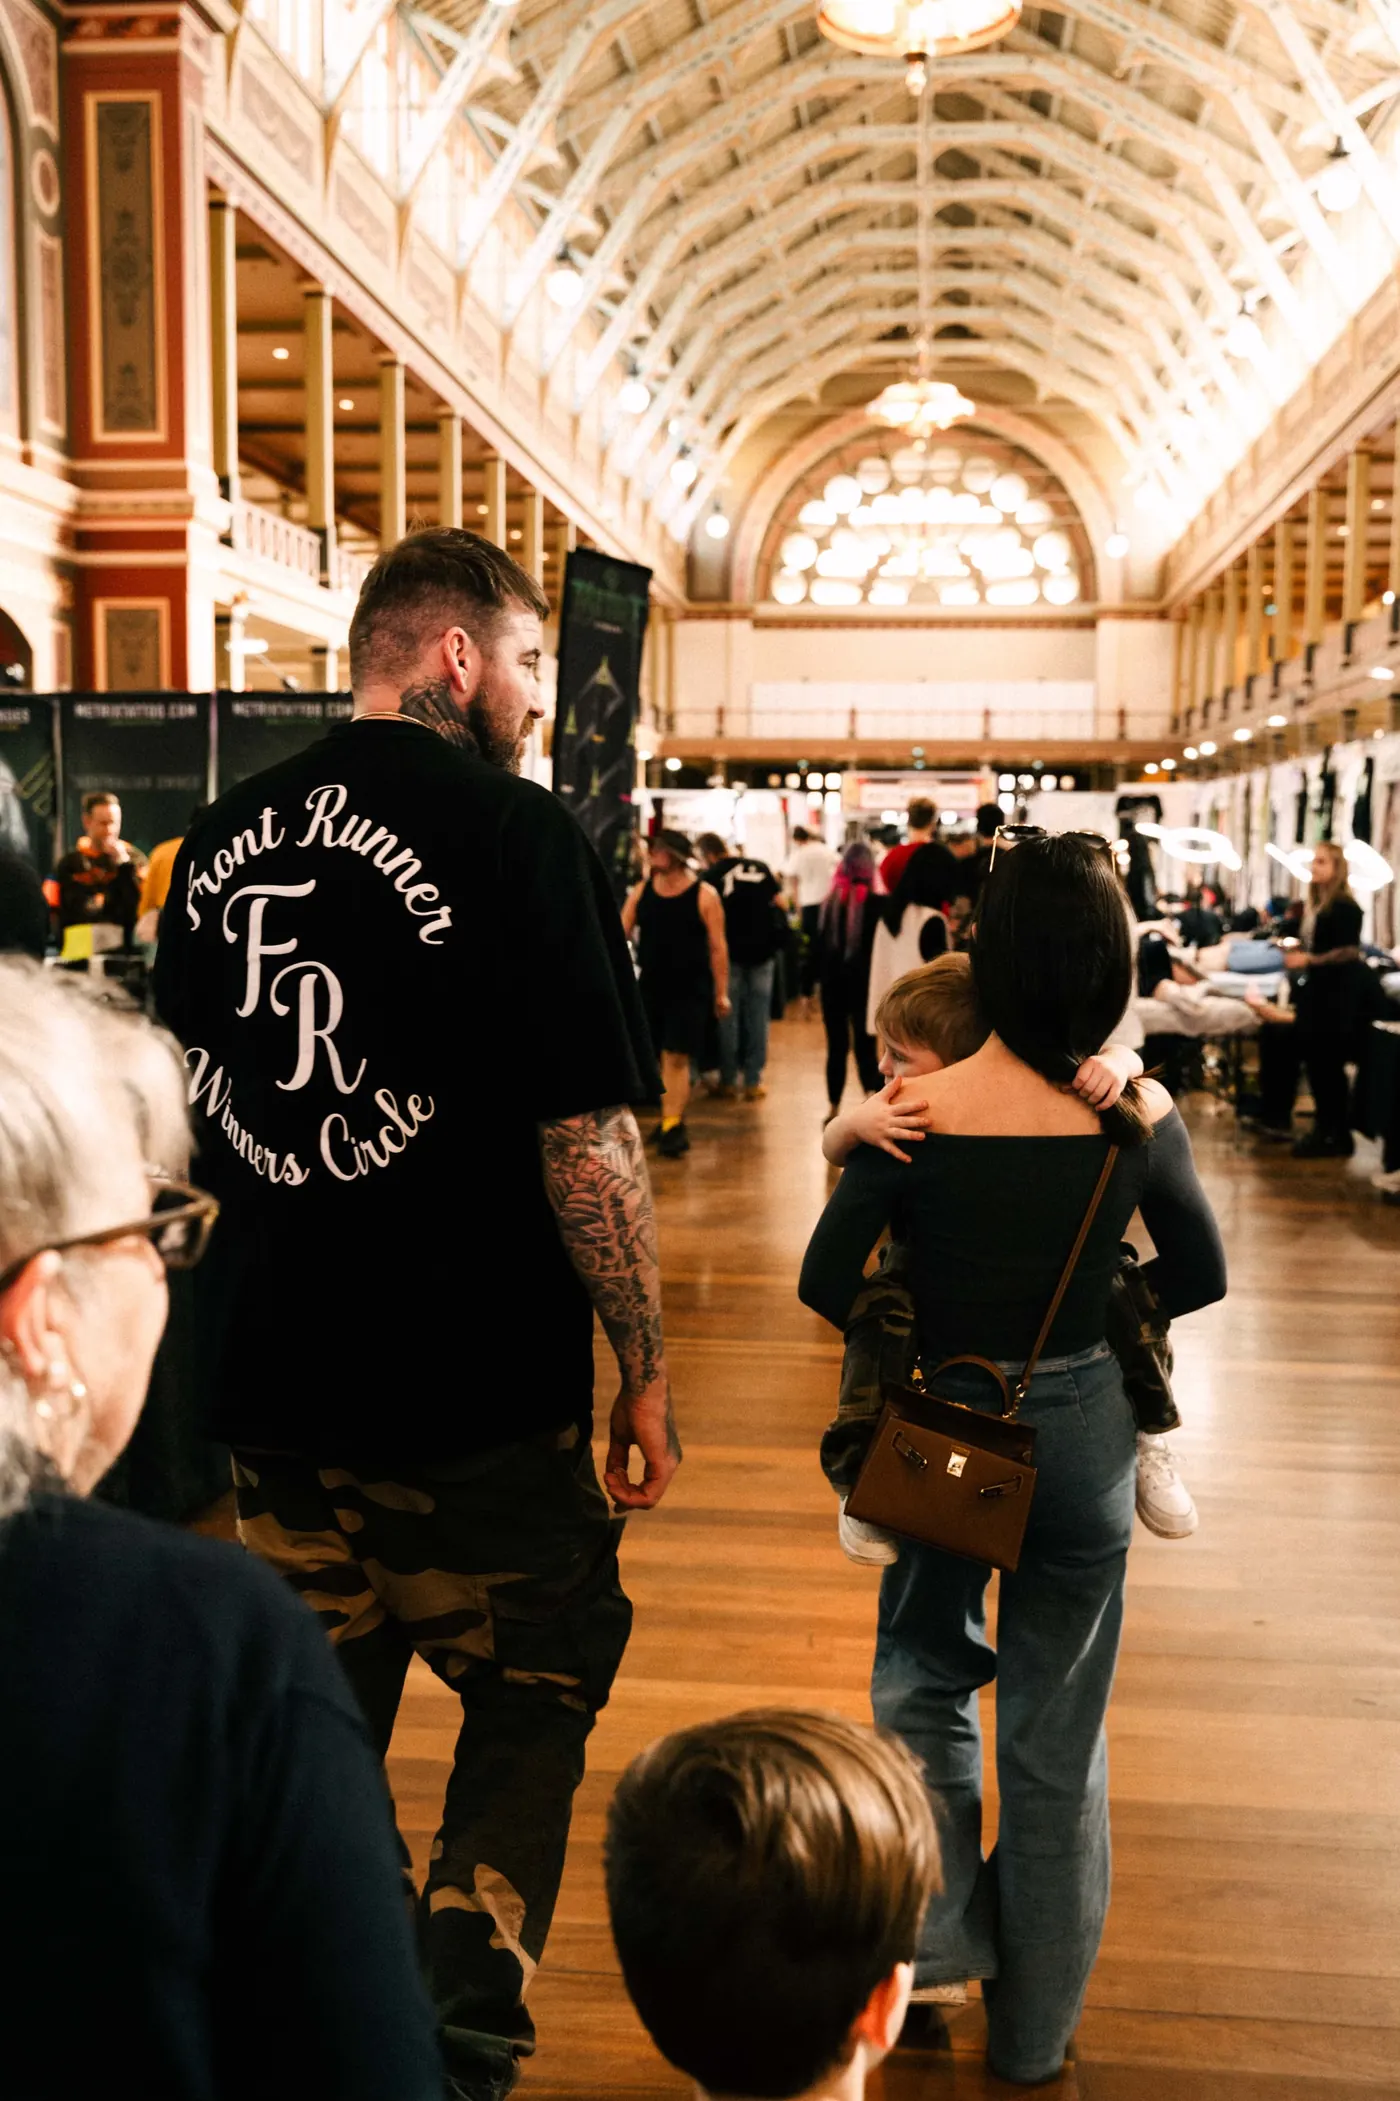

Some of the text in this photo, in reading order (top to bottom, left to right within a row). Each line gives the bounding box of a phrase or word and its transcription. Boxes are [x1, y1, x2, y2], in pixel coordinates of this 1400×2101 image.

[295, 784, 453, 945] Runner
[184, 1046, 435, 1186] Winners Circle
